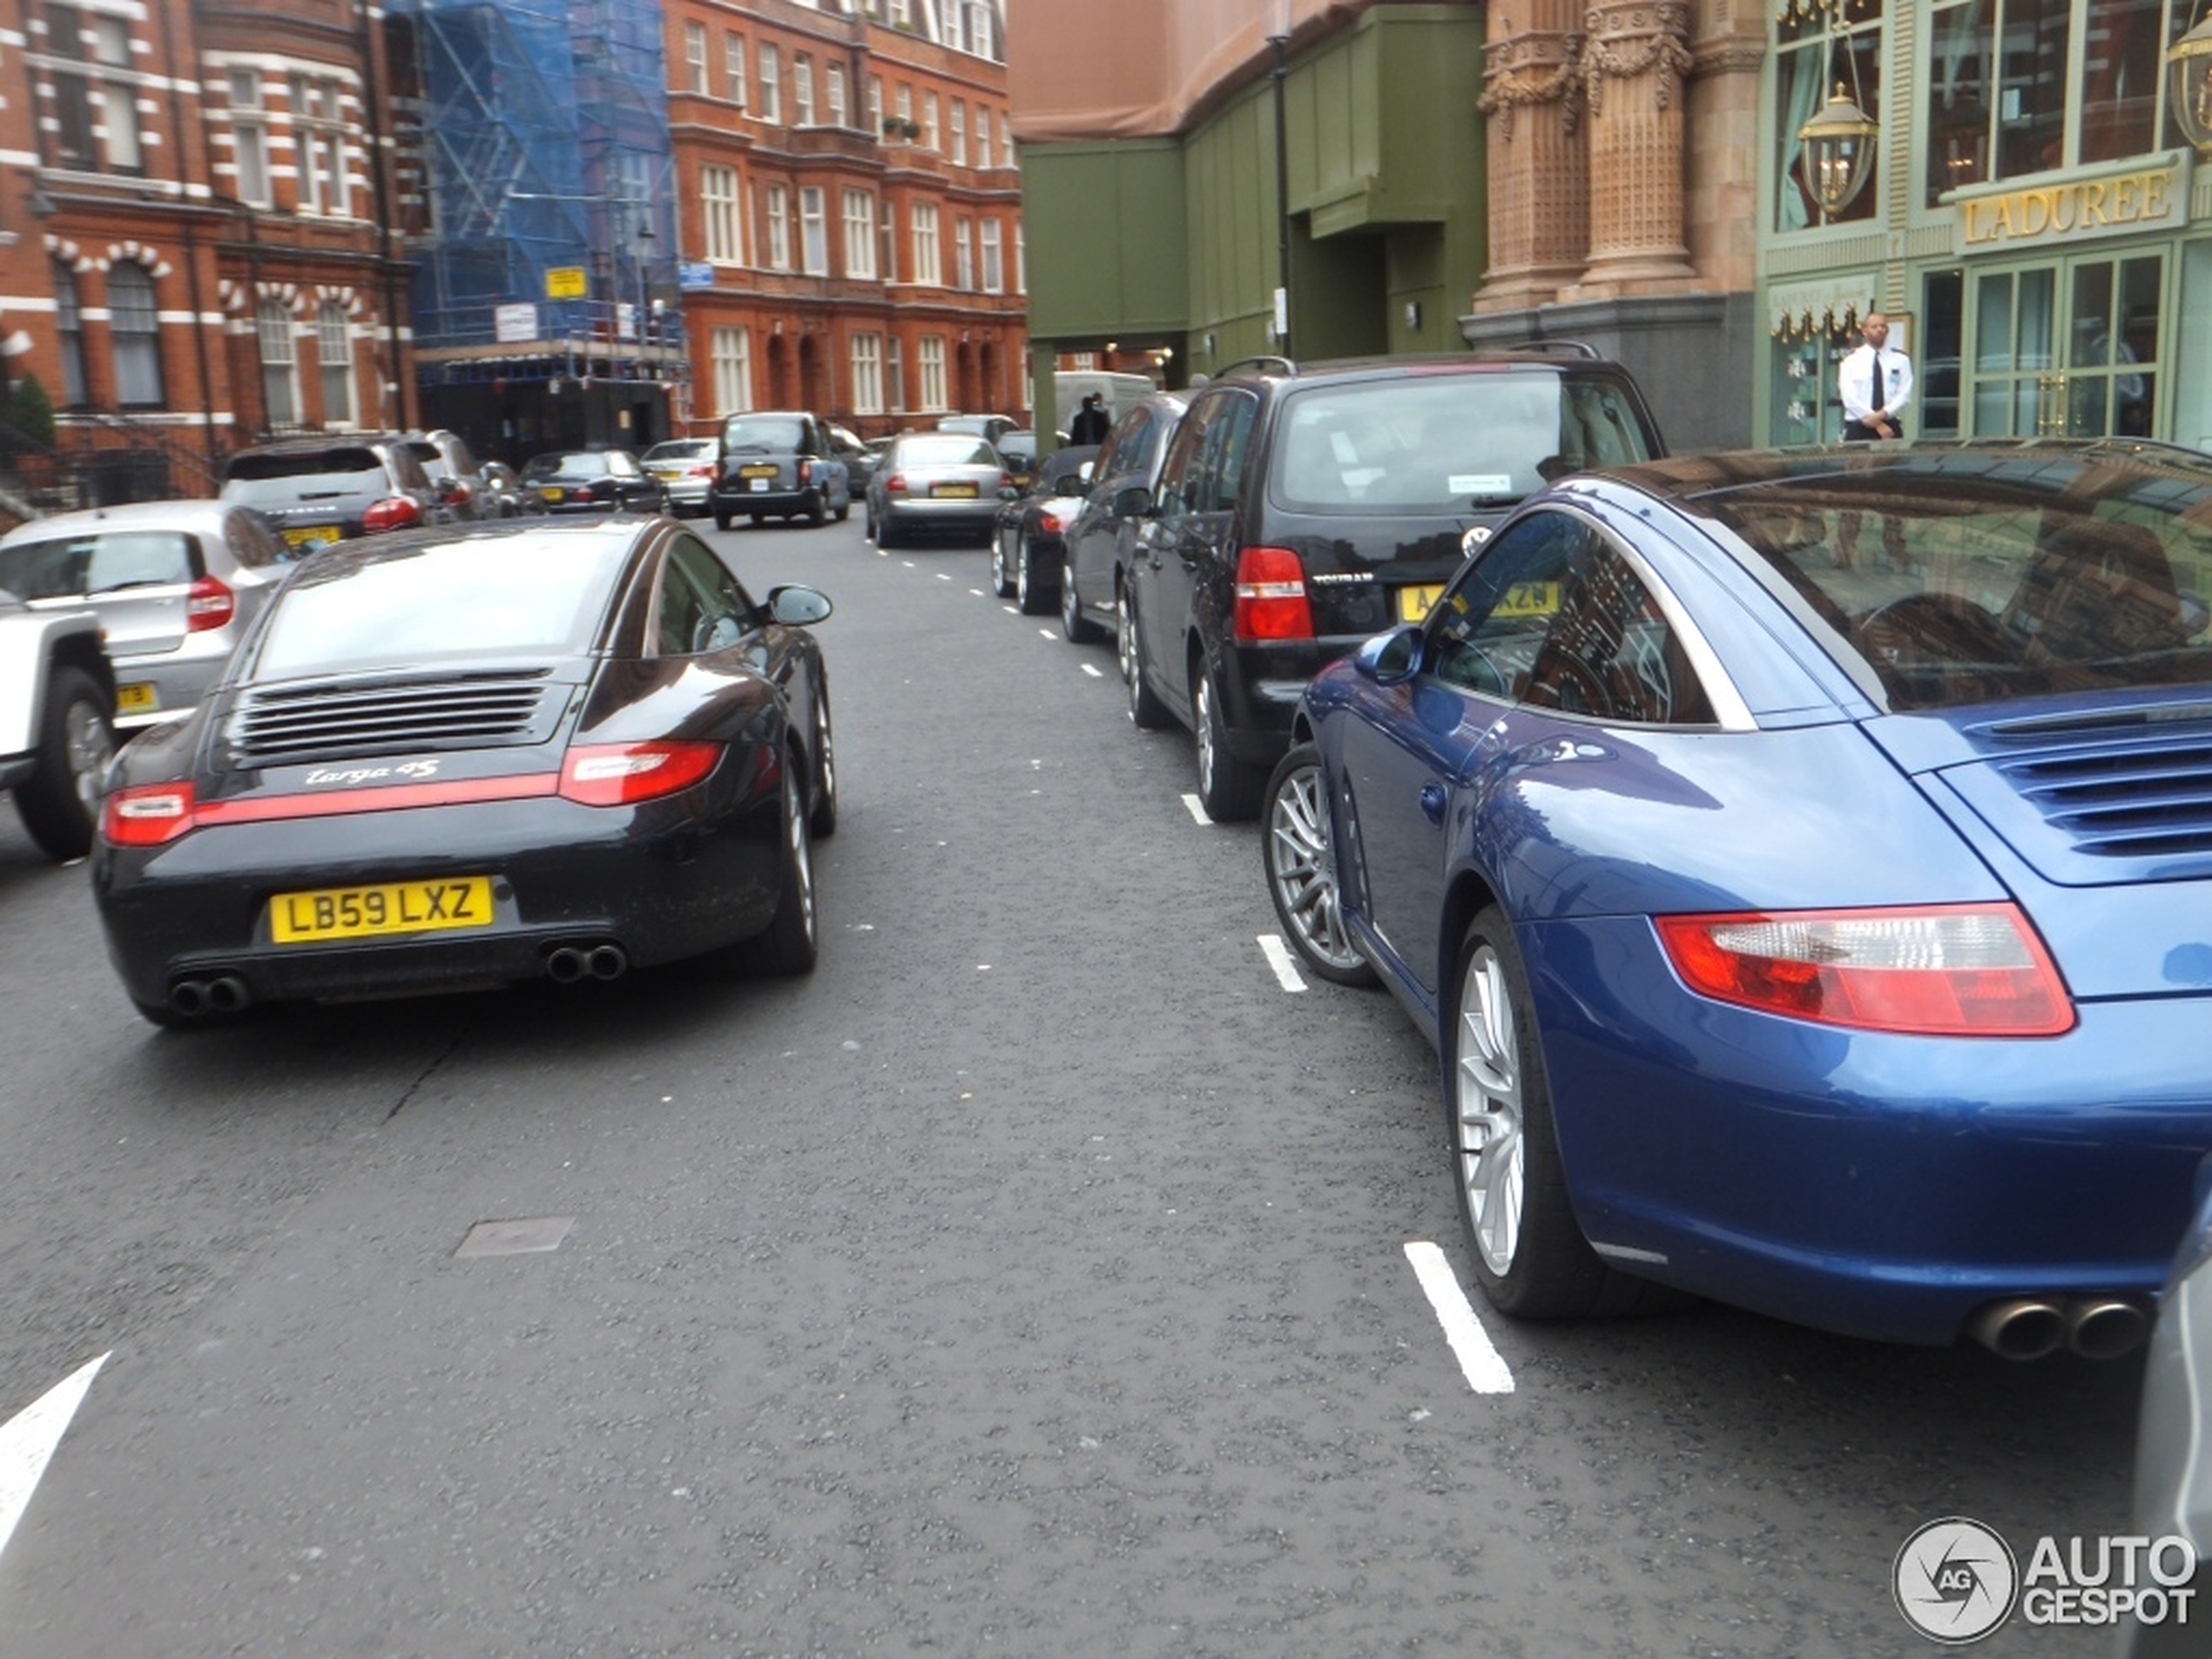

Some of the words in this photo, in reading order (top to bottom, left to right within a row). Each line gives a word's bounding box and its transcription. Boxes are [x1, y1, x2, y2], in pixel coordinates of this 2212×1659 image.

[306, 768, 391, 785] targa
[287, 891, 387, 933] LB59
[398, 883, 473, 923] LXZ
